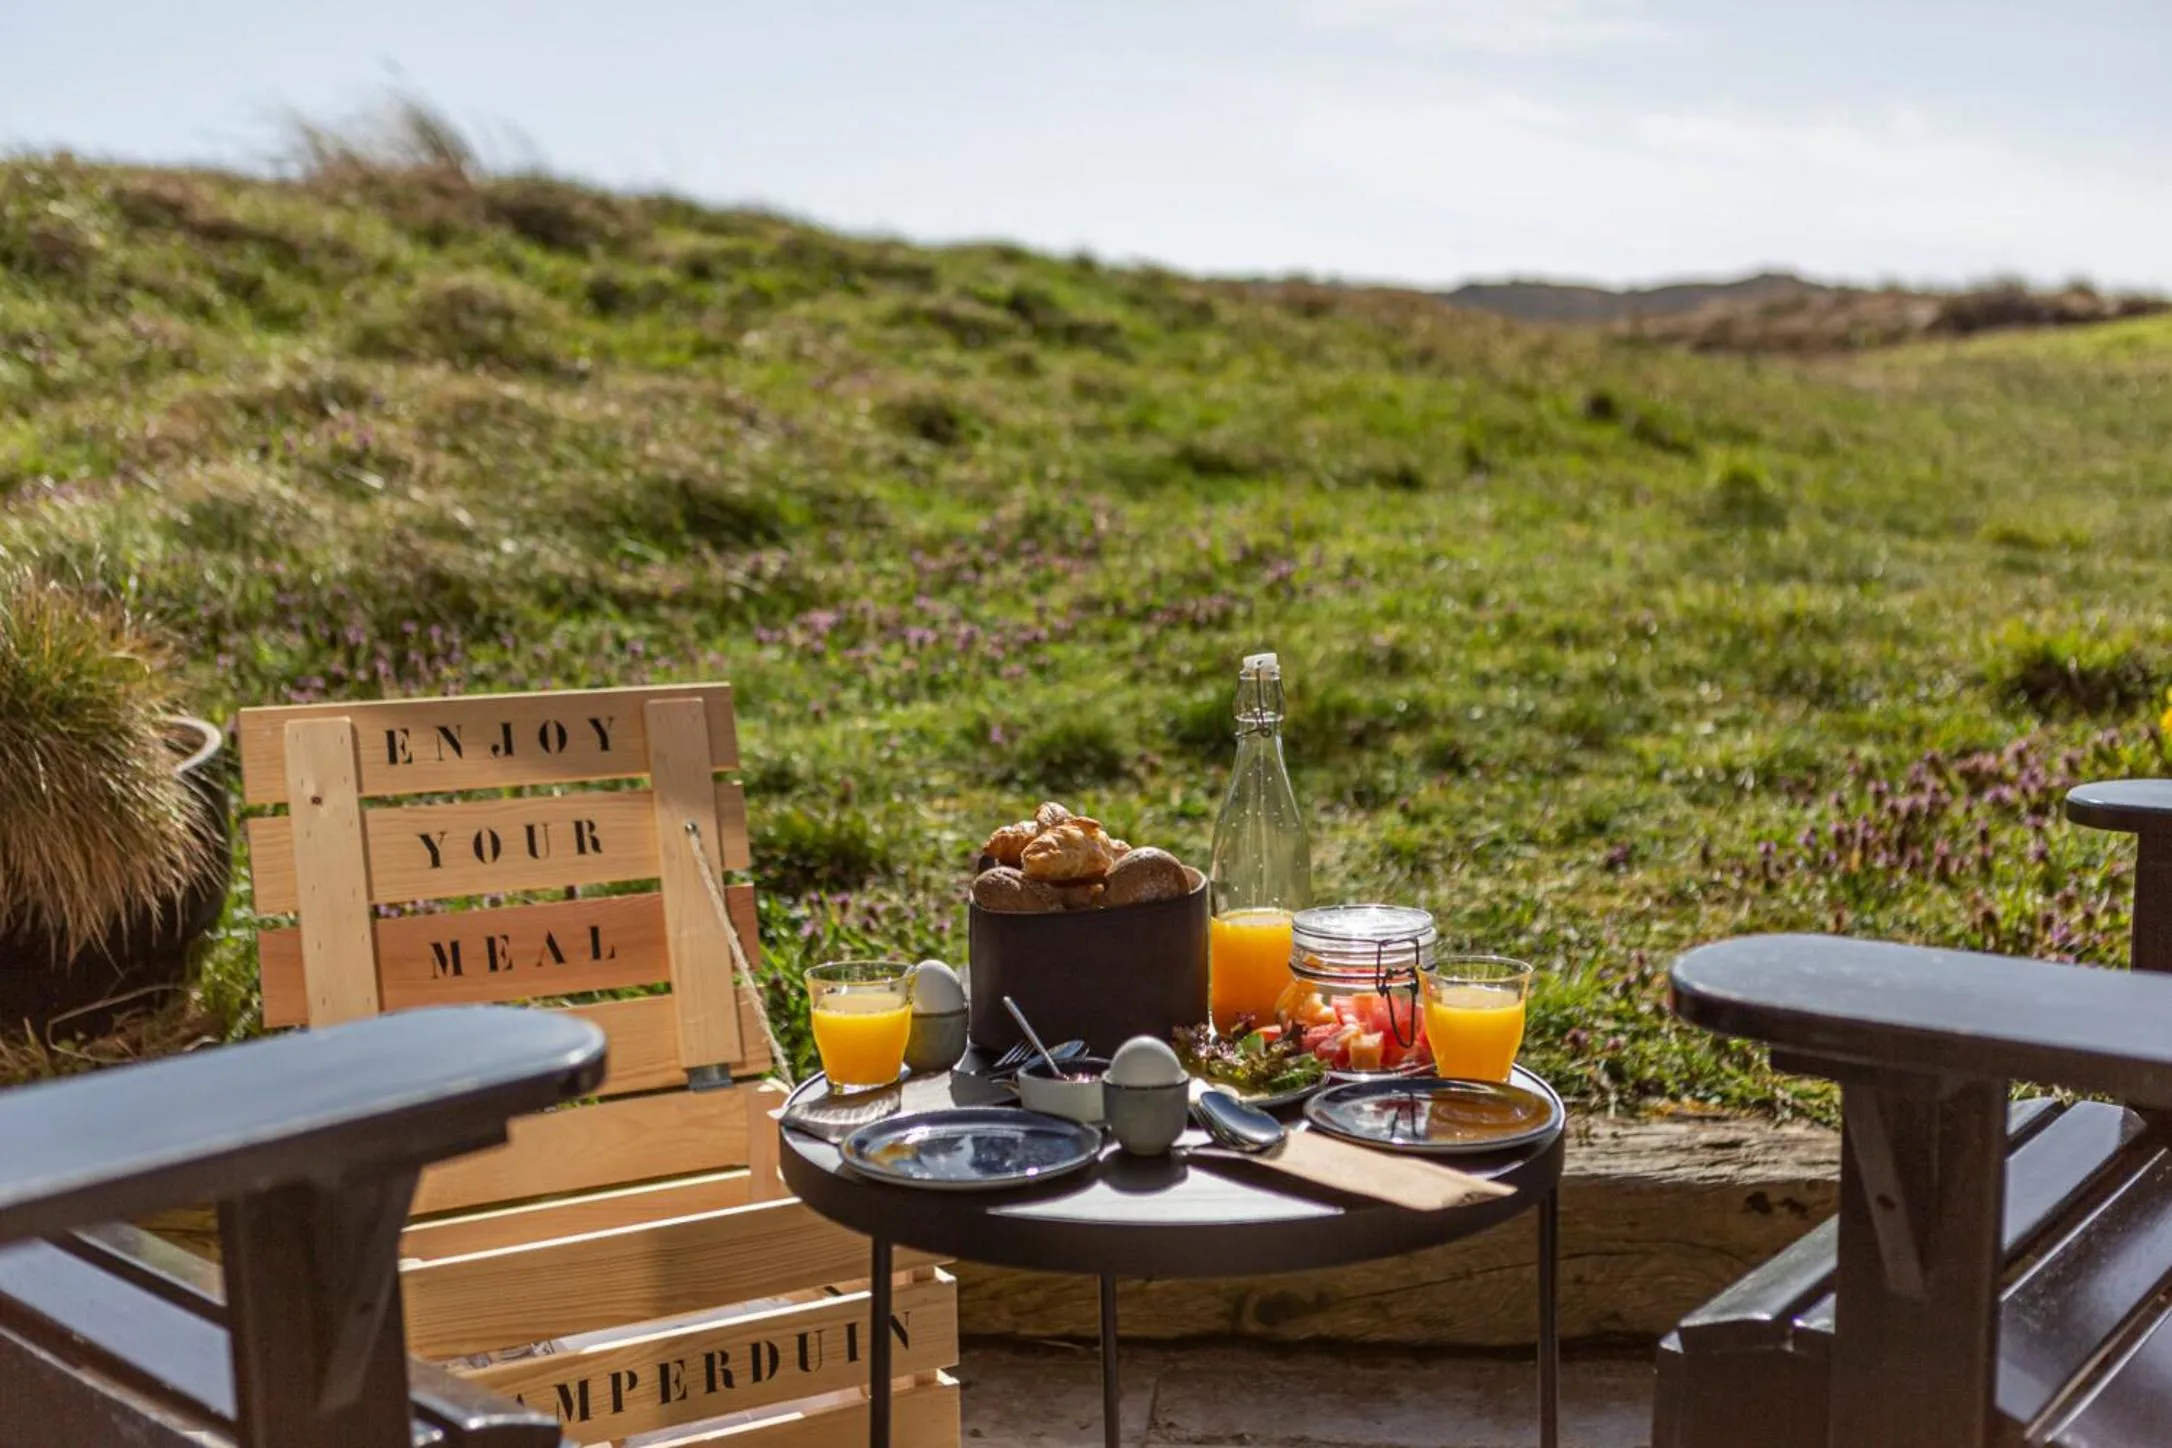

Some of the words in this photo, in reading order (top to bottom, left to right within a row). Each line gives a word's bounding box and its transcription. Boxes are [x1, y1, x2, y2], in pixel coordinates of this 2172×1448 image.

[385, 716, 616, 765] ENJOY
[417, 818, 602, 869] YOUR
[428, 925, 616, 979] MEAL
